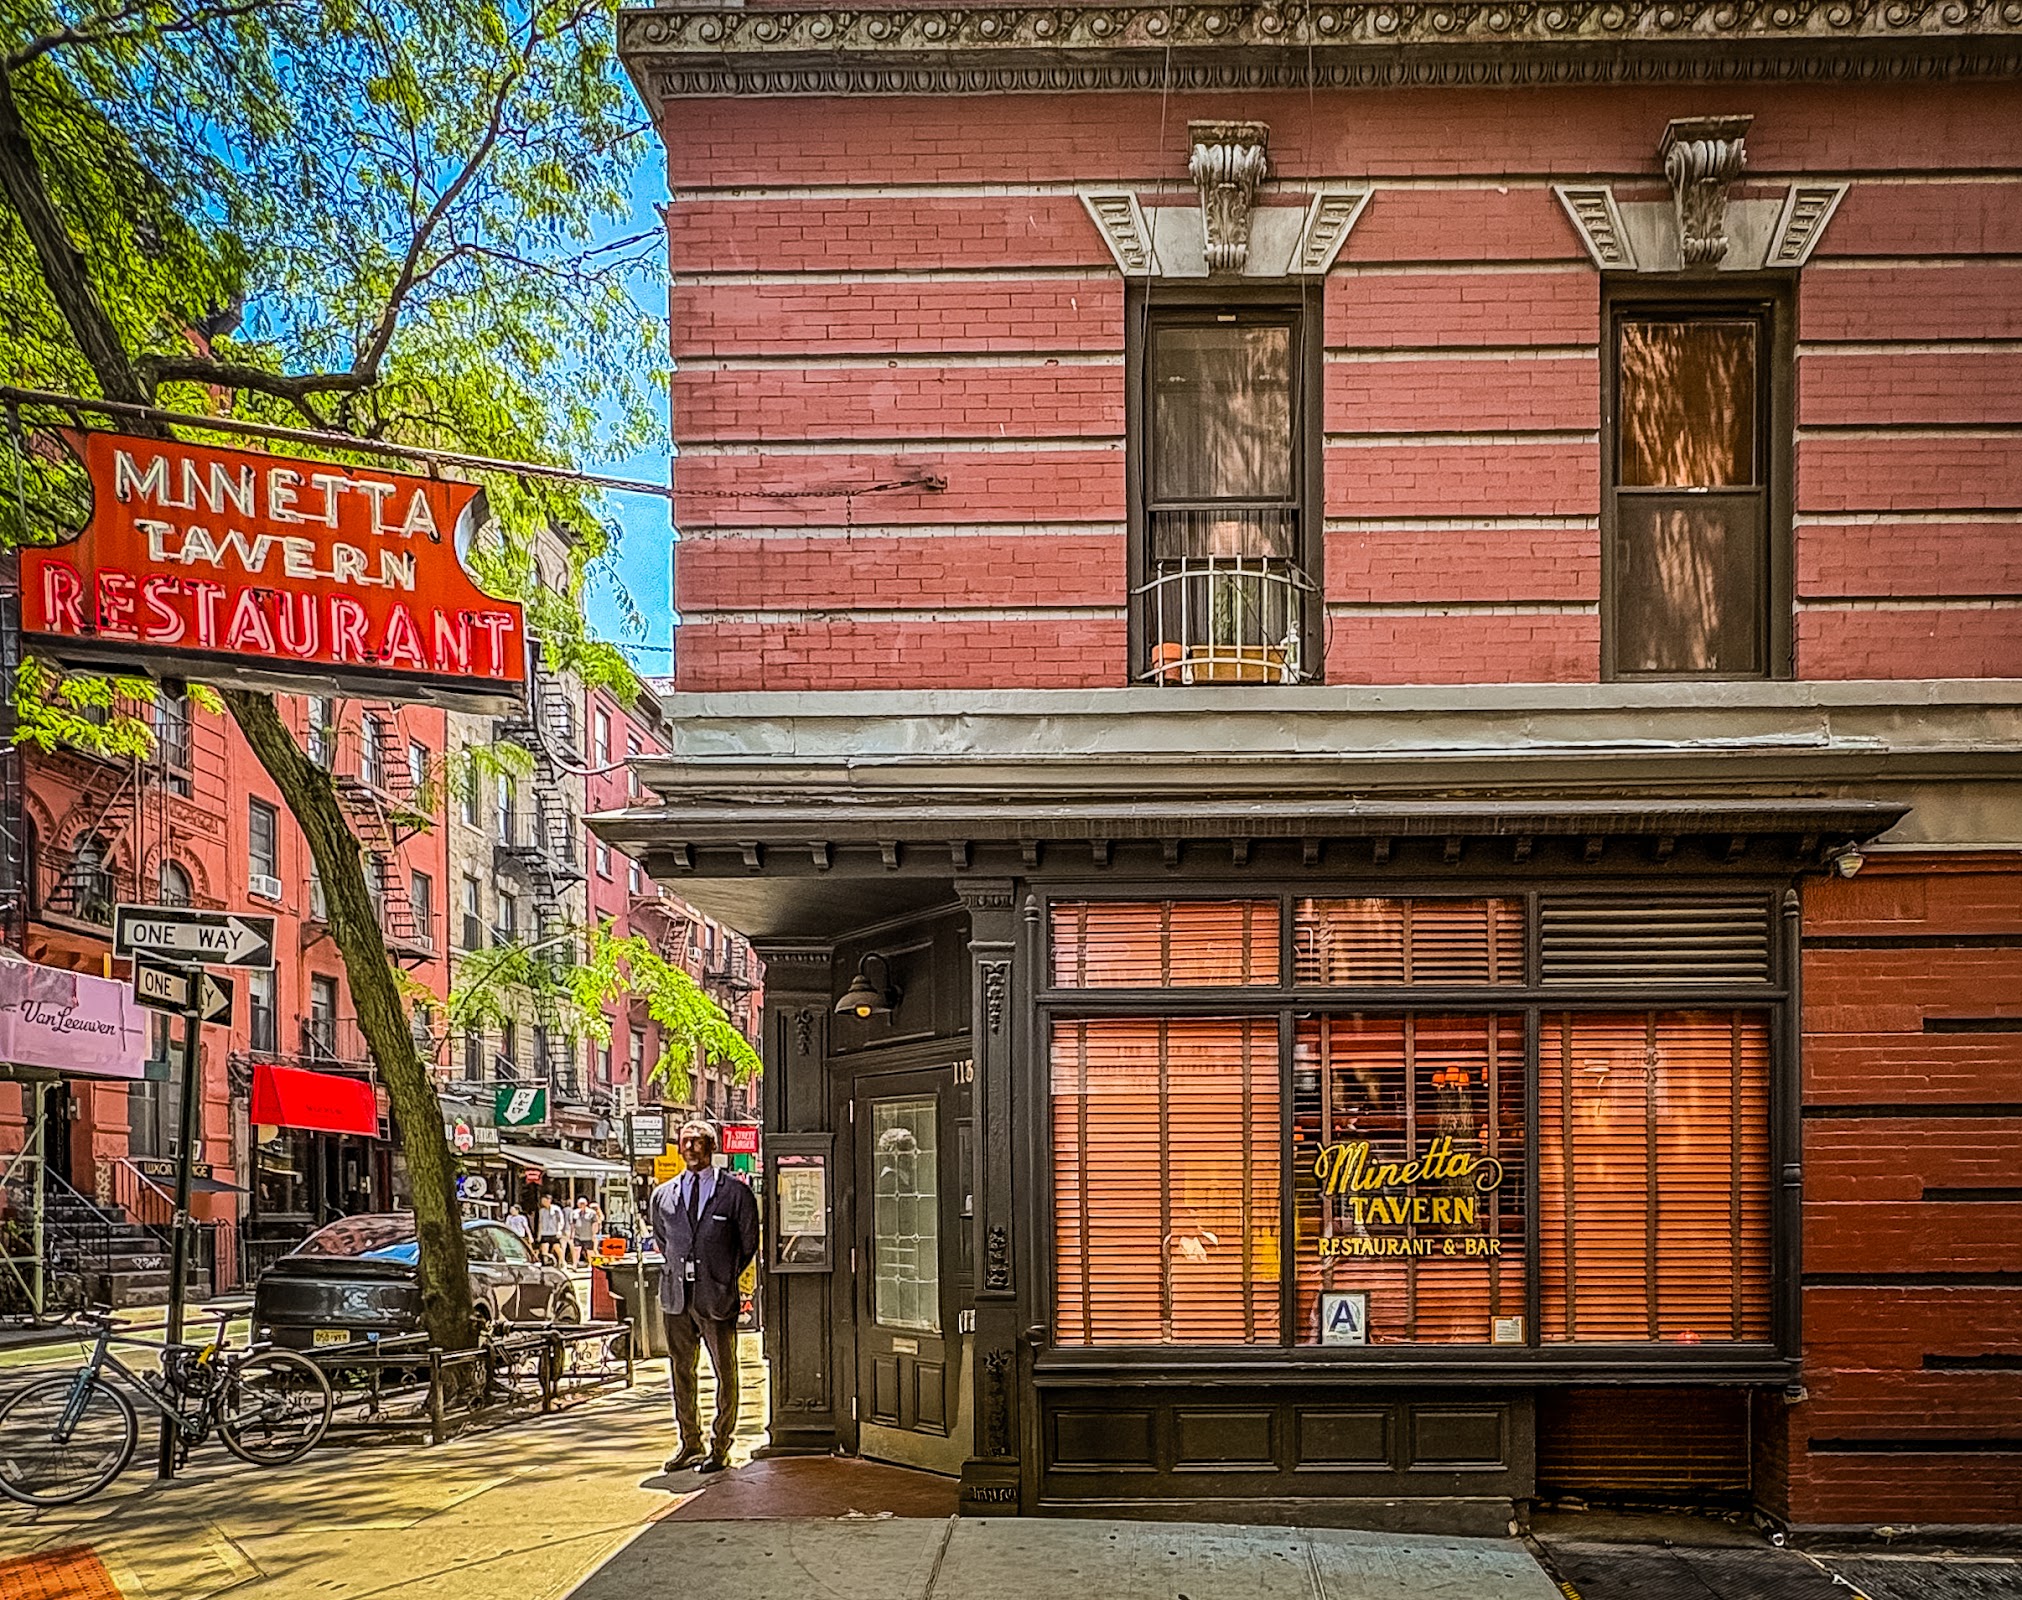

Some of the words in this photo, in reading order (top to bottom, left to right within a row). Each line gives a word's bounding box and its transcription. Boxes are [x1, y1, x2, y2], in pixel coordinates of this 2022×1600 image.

[113, 449, 441, 543] MINETTA
[134, 518, 416, 592] TAVERN
[39, 560, 514, 676] RESTAURANT
[133, 923, 176, 946] ONE
[198, 928, 243, 951] WAY
[145, 971, 172, 997] ONE
[143, 1162, 173, 1176] LUXOR
[1314, 1136, 1503, 1195] Minetta
[1349, 1197, 1474, 1225] TAVERN
[1318, 1238, 1435, 1256] RESTAURANT
[1443, 1238, 1456, 1255] &
[1465, 1238, 1502, 1256] BAR
[1329, 1300, 1358, 1332] A
